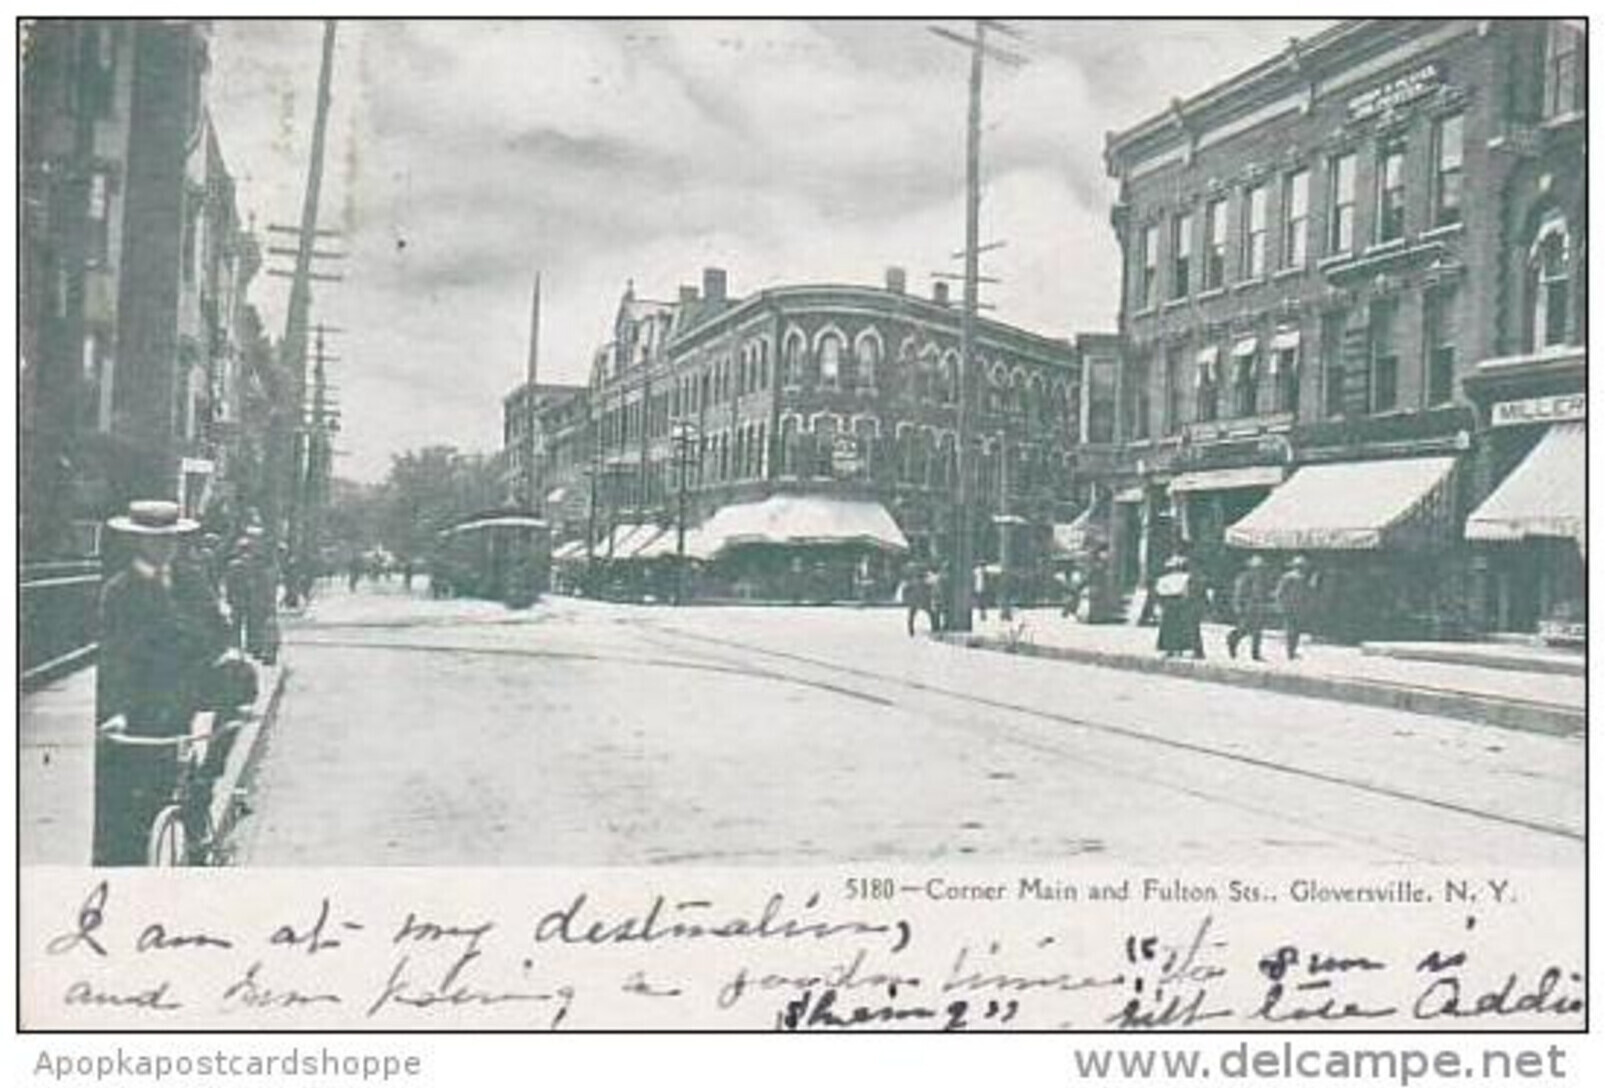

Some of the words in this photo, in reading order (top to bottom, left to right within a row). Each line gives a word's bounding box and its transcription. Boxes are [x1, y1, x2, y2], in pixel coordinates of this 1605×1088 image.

[1018, 877, 1078, 901] Main
[1088, 879, 1129, 901] and
[1143, 878, 1217, 901] Fulton
[136, 923, 232, 950] am
[394, 913, 493, 992] my
[65, 982, 182, 1009] and
